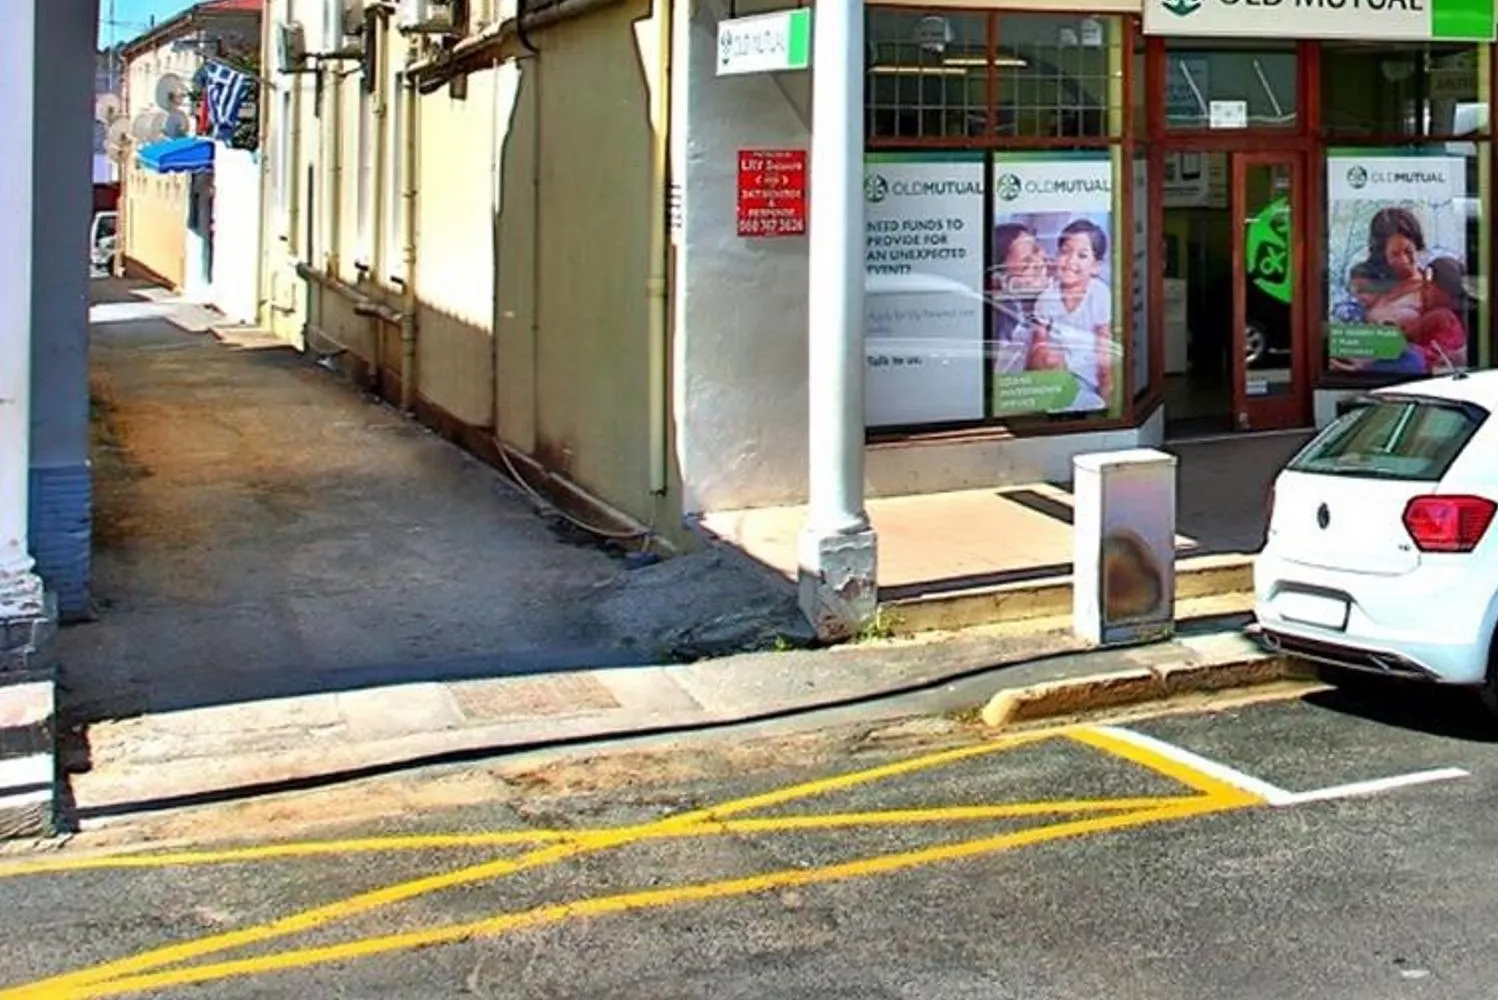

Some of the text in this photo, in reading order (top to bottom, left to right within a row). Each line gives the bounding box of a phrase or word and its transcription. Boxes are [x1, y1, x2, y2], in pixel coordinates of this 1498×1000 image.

[867, 218, 965, 232] NEED FUNDS TO
[867, 233, 948, 247] PROVIDE FOR
[867, 248, 967, 262] AN UNEXPECTED
